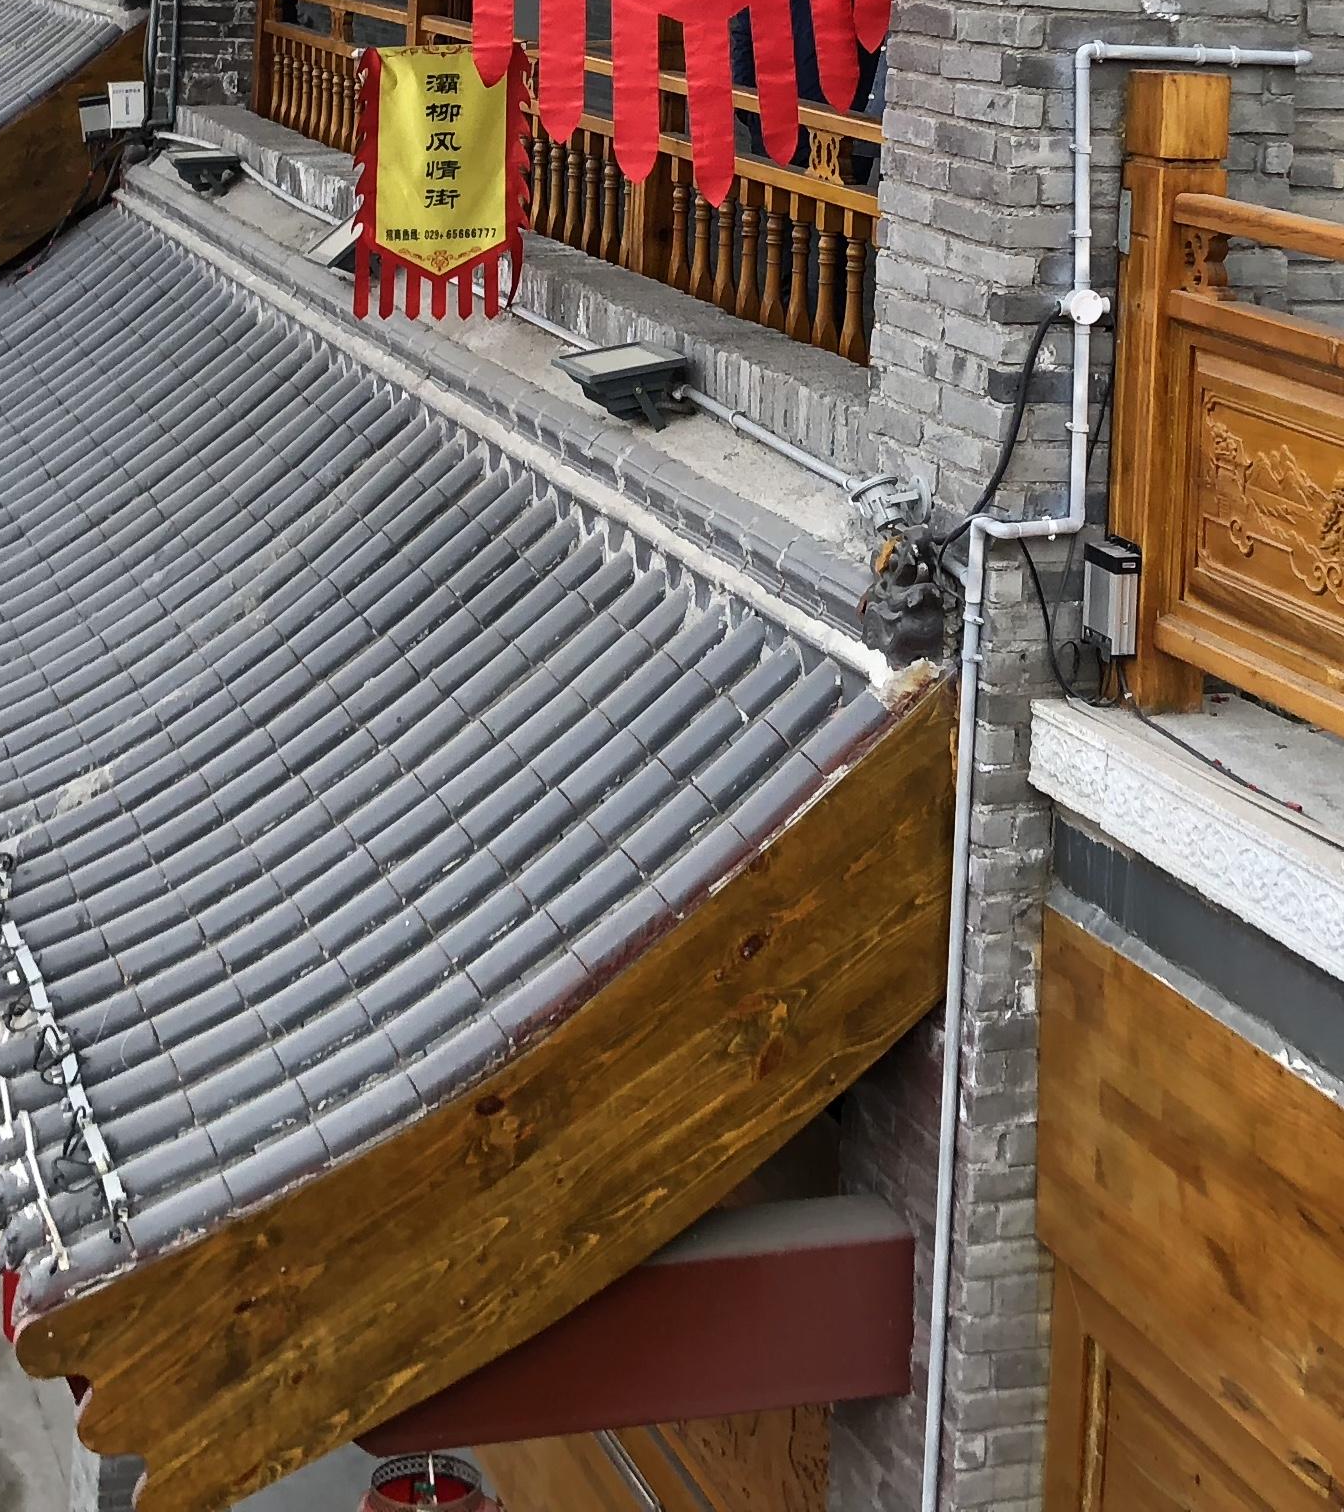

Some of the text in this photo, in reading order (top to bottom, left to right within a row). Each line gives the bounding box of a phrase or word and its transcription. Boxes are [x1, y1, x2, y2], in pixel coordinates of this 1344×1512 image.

[424, 74, 461, 209] 灞柳风情街
